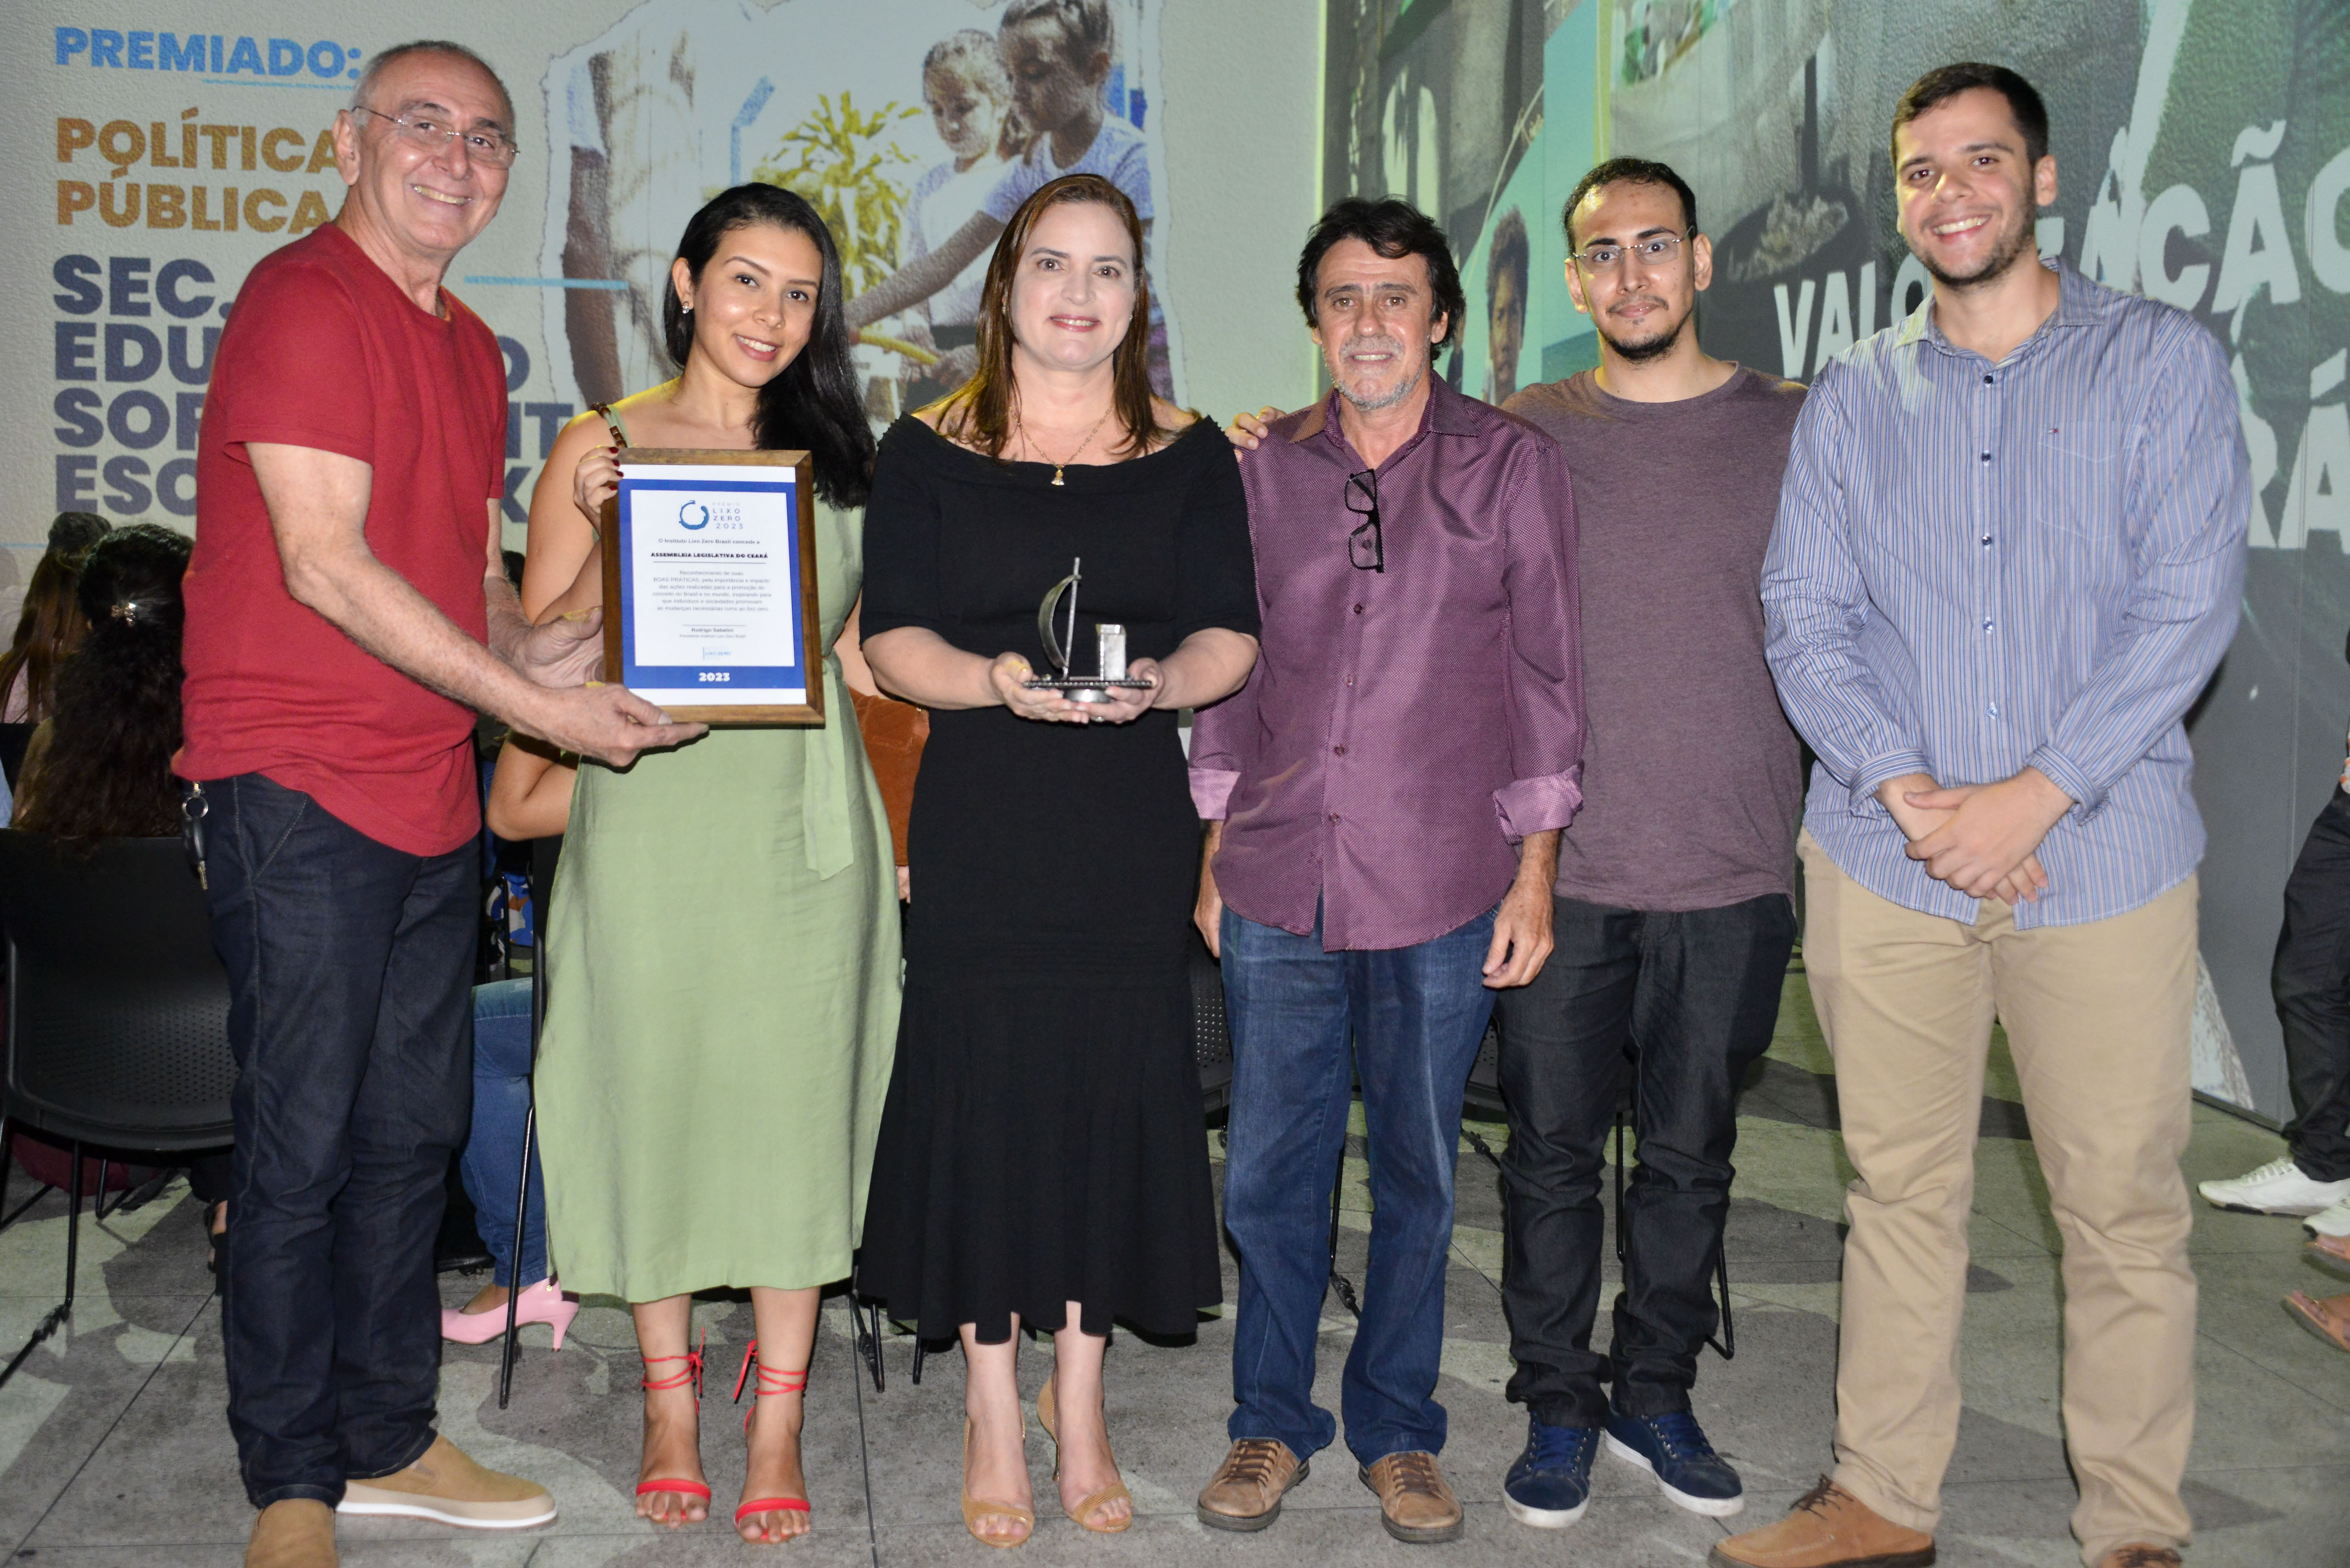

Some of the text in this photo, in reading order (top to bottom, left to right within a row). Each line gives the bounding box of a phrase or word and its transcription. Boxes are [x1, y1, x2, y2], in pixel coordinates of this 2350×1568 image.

[55, 27, 361, 80] PREMIADO:
[57, 107, 337, 173] POLÍTICA
[57, 167, 332, 234] PÚBLICA
[699, 672, 730, 681] 2023
